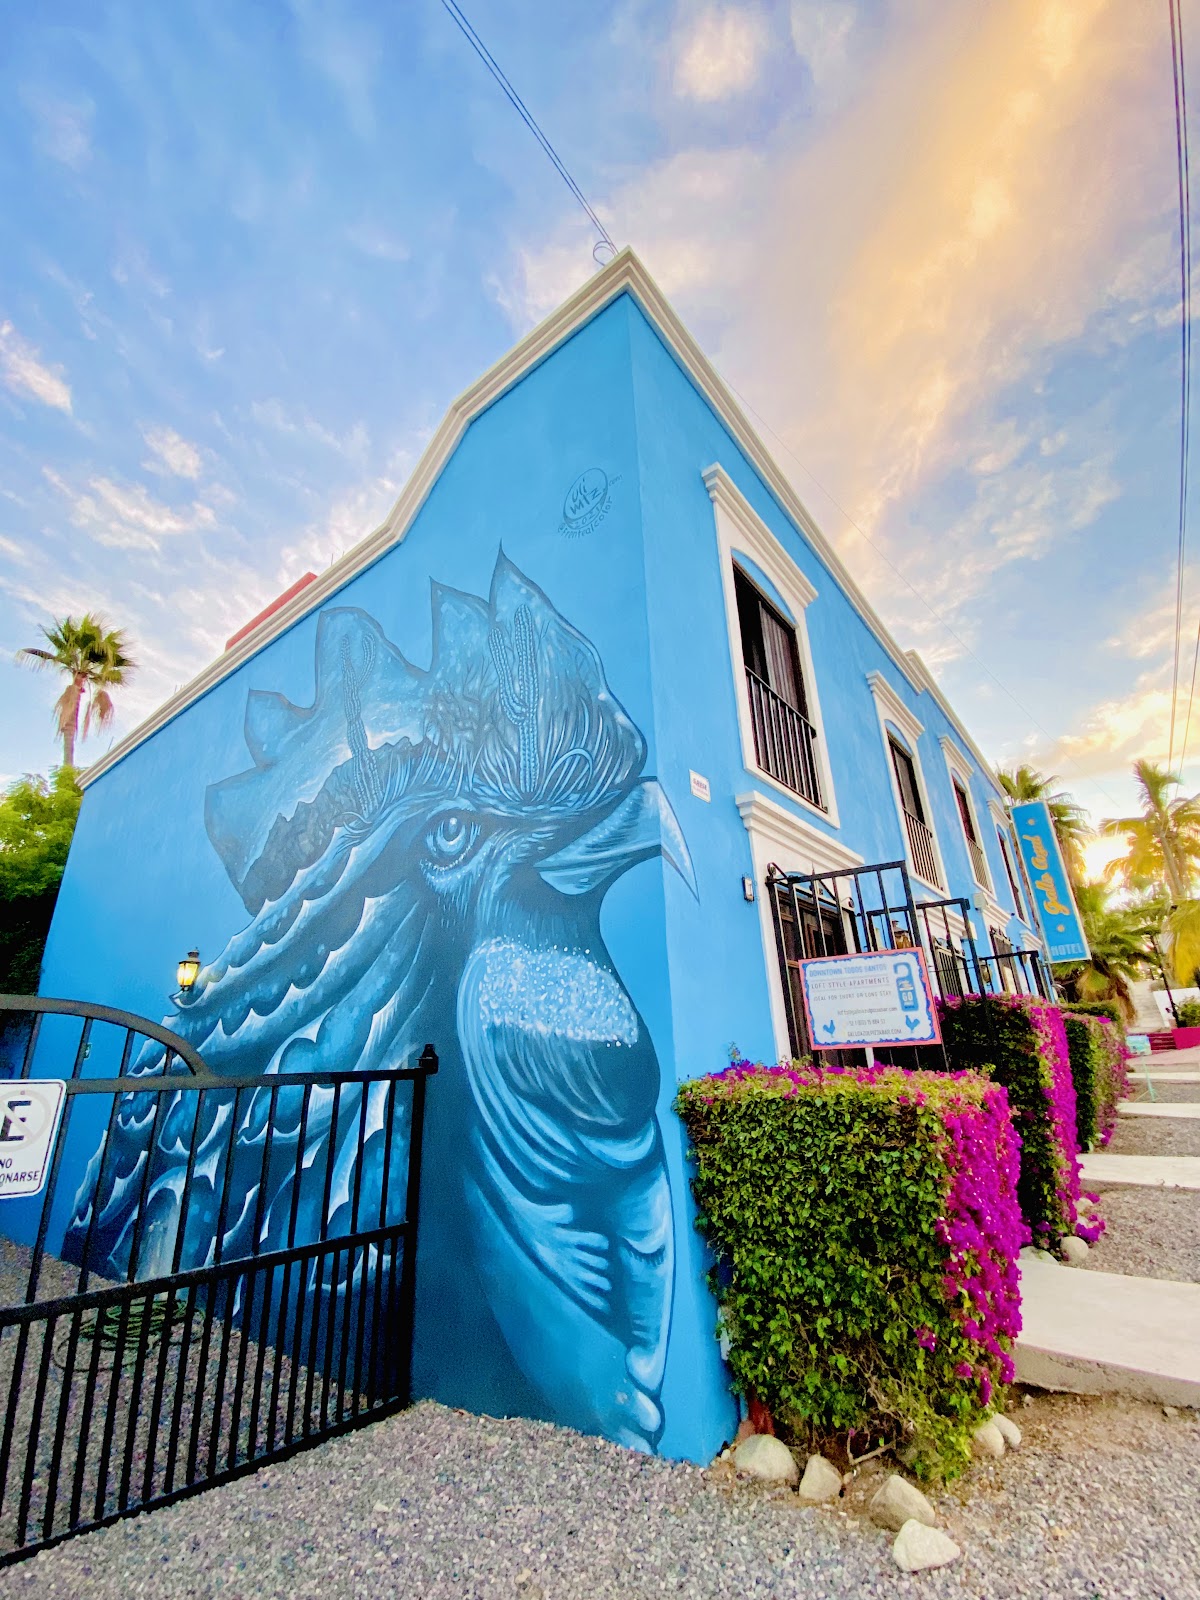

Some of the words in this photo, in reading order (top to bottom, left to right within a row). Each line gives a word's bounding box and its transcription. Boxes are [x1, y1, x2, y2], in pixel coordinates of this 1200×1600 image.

[1050, 943, 1084, 957] HOTEL
[809, 967, 843, 977] DOWNTOWN
[828, 980, 848, 988] STYLE
[849, 977, 890, 987] APARTMENTS
